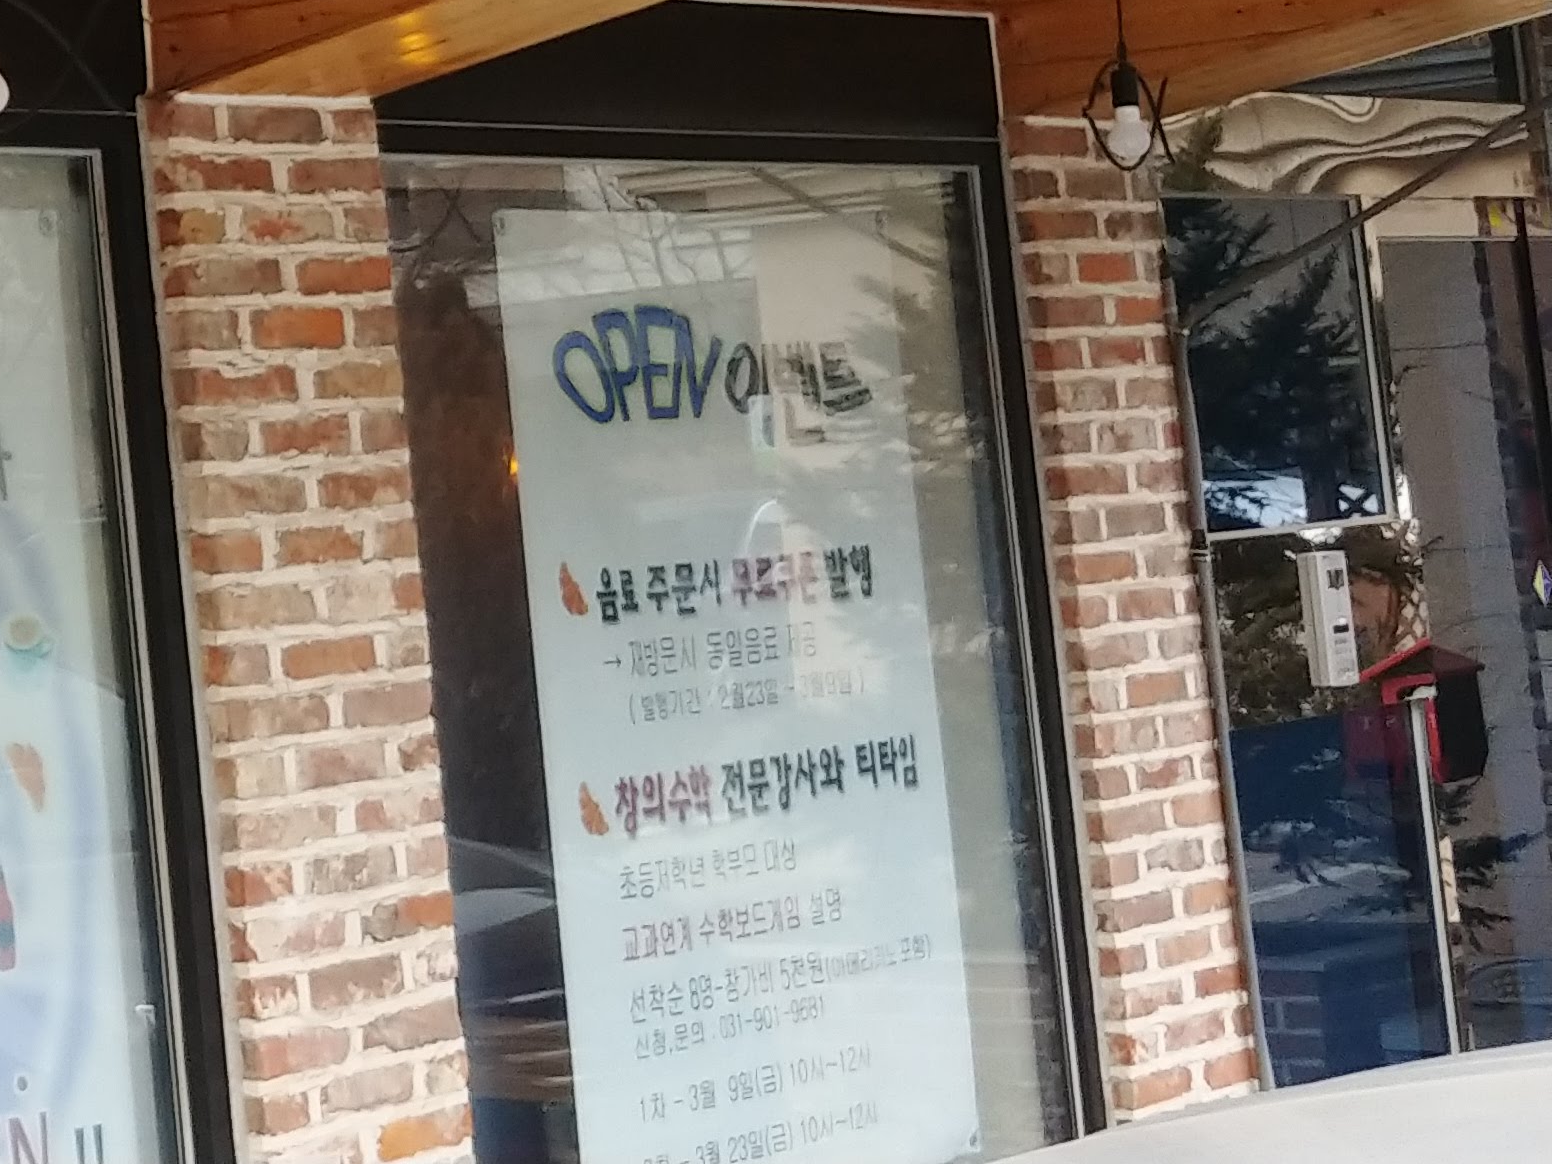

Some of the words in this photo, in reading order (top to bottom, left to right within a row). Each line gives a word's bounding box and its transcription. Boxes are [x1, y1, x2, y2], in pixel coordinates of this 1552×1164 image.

[552, 303, 722, 423] OPEN
[596, 567, 639, 623] 음료
[647, 559, 722, 616] 주문시
[823, 544, 872, 600] 발행
[707, 626, 778, 670] 동일음료
[615, 764, 712, 838] 창의수학
[721, 741, 844, 820] 전문강사와
[854, 734, 919, 791] 티타임
[620, 856, 705, 899] 초등저학년
[712, 844, 759, 882] 학부모
[765, 838, 796, 872] 대상
[622, 917, 692, 962] 교과연계
[699, 895, 800, 943] 수학보드게임
[810, 887, 842, 926] 설명
[630, 981, 683, 1024] 선착순
[640, 1092, 665, 1124] 1차
[689, 1080, 716, 1112] 3월
